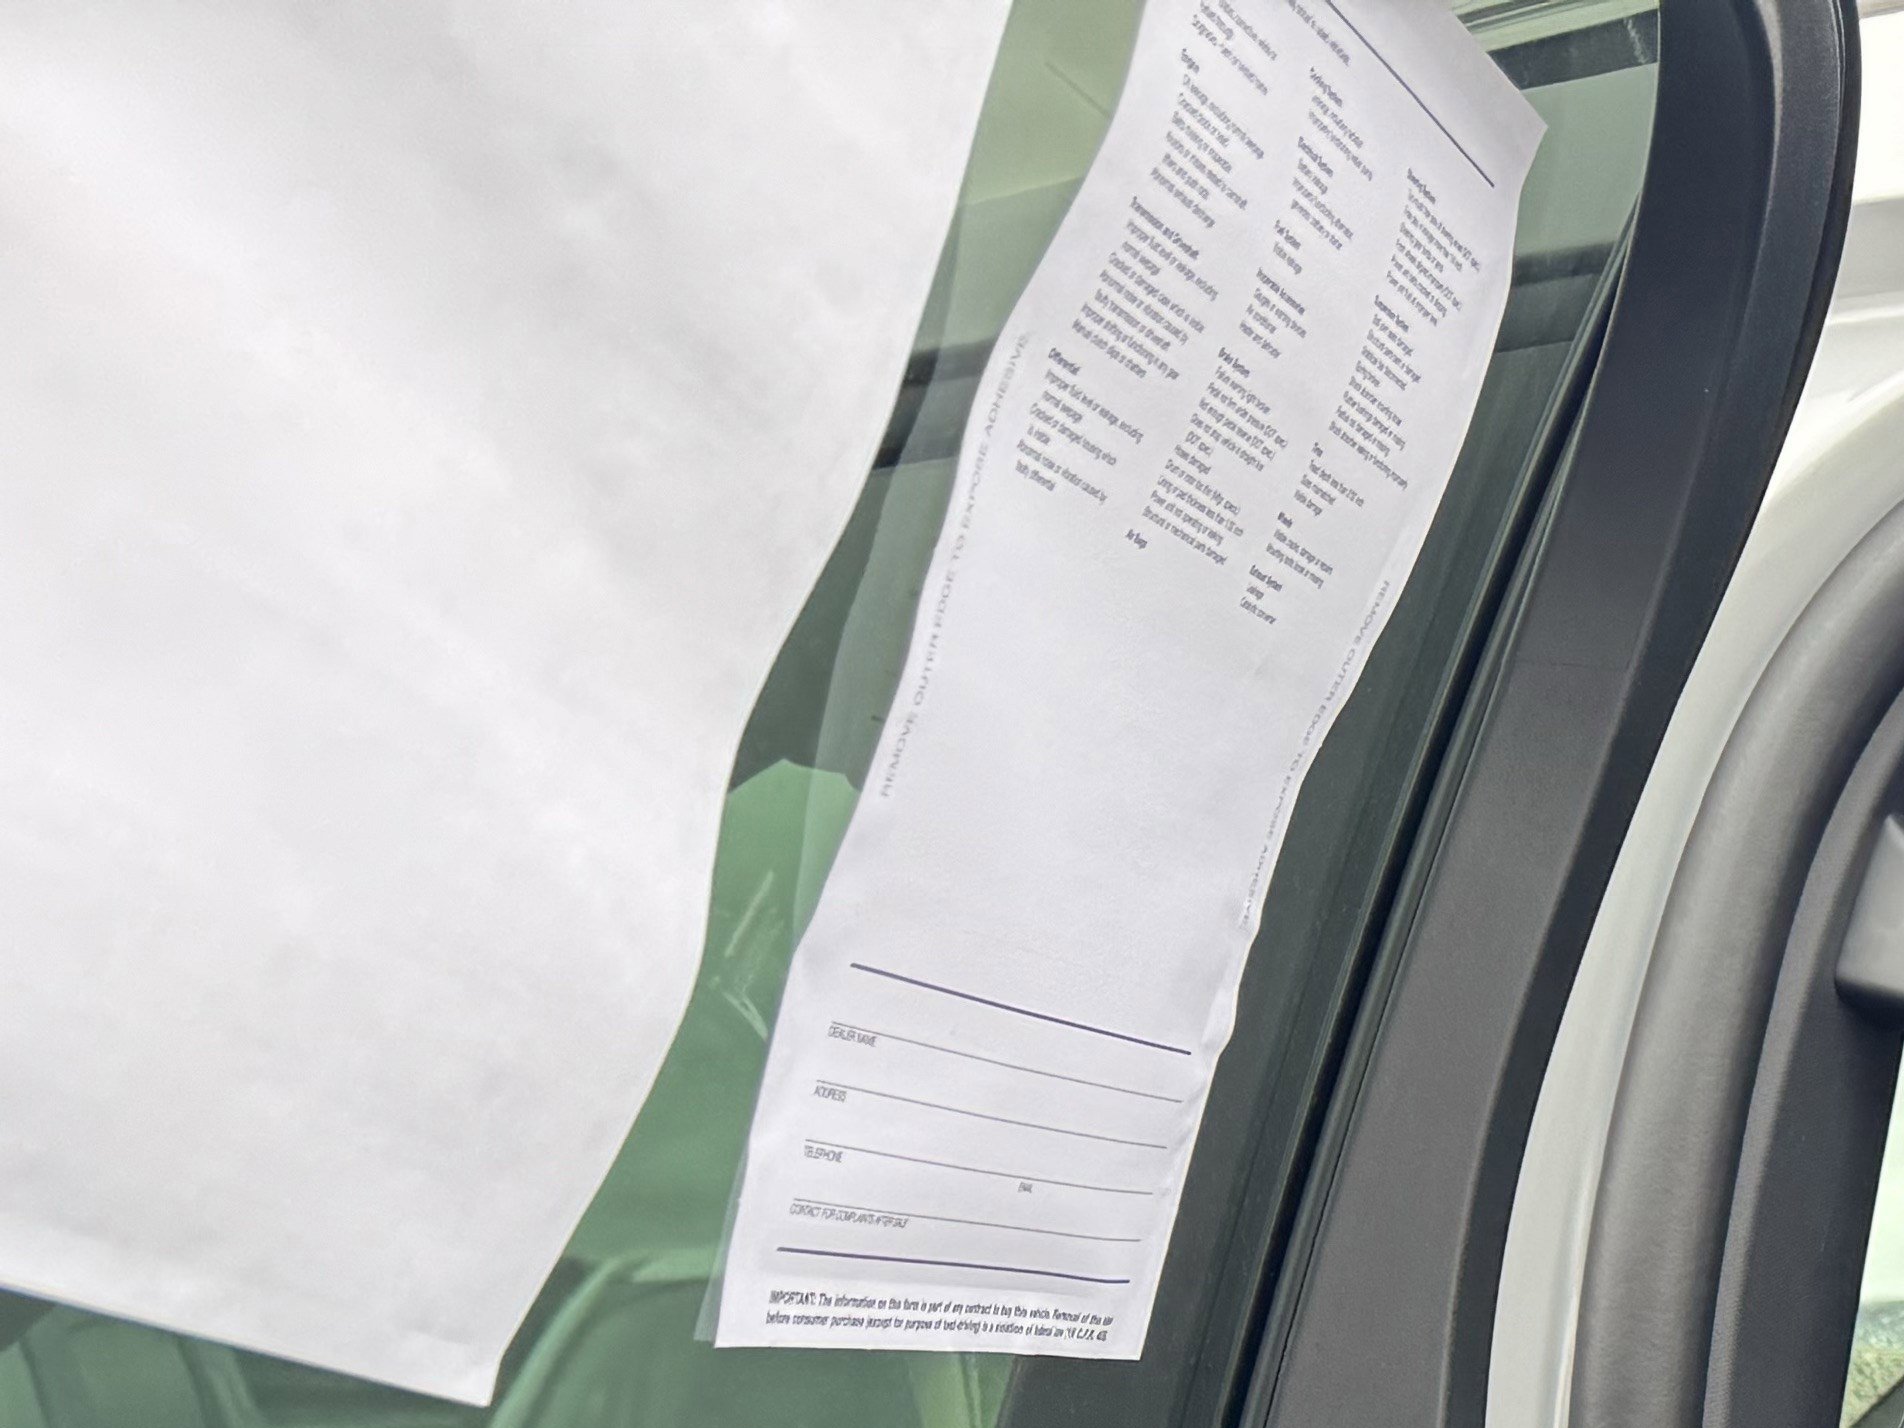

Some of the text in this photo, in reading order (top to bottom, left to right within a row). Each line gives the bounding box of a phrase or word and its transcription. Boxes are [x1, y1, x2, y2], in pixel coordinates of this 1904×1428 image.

[933, 569, 957, 628] EDGE
[1353, 580, 1390, 645] REMOVE
[1325, 648, 1356, 701] OUTER
[1303, 704, 1326, 746] EDGE
[766, 1311, 790, 1325] before
[792, 1315, 829, 1326] consumer
[830, 1315, 864, 1329] purchase
[769, 1291, 816, 1305] IMPORTANT:
[819, 1293, 832, 1307] The
[834, 1294, 875, 1308] information
[965, 1304, 992, 1314] contract
